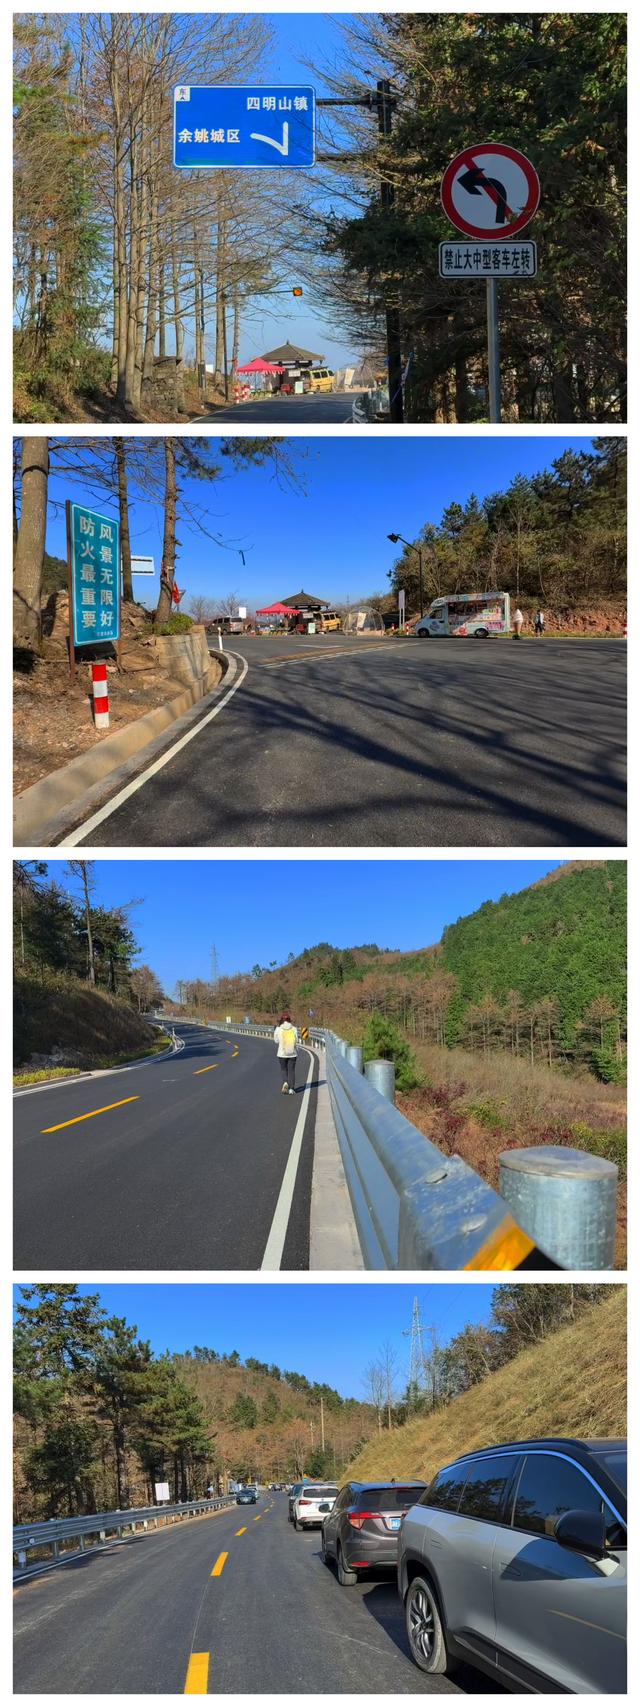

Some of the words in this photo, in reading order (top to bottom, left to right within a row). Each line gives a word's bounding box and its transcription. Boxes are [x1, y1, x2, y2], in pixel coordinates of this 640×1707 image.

[246, 96, 308, 111] 四明山镇
[178, 128, 240, 143] 余姚城区
[444, 248, 530, 270] 禁止大中型客车左转
[80, 515, 96, 628] 防火最重要
[99, 523, 114, 627] 风景无限好
